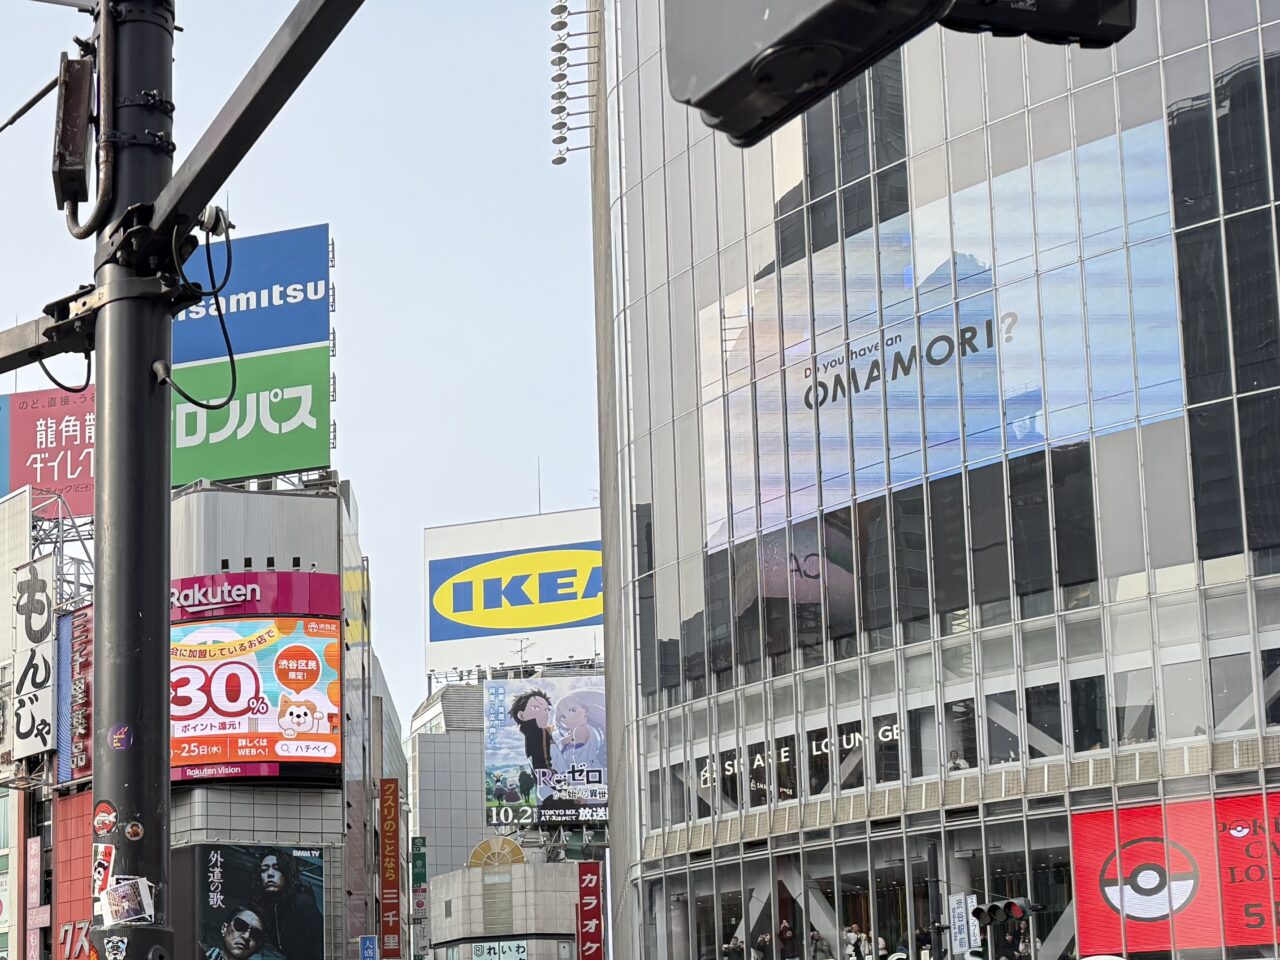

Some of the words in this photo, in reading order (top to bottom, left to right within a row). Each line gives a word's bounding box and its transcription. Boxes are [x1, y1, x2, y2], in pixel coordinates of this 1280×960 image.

[804, 312, 1018, 410] OMAMORI?
[822, 355, 844, 375] you
[851, 341, 879, 360] have
[885, 334, 902, 349] an
[170, 582, 260, 607] Rakuten
[16, 565, 52, 747] もんじゃ
[278, 660, 317, 670] 渋谷区民
[181, 721, 241, 733] ポイント還元!
[238, 739, 268, 747] 詳しくは
[238, 747, 268, 756] WEBへ!
[296, 744, 328, 753] ハチペイ
[186, 766, 217, 777] Rakuten
[218, 766, 241, 775] Vision
[490, 807, 532, 824] 10.2
[579, 807, 608, 820] 放送
[383, 783, 396, 880] クスリのことなら
[208, 851, 225, 909] 外道の歌
[382, 889, 399, 950] 三千里
[956, 899, 966, 948] 渋谷駅前
[486, 944, 527, 956] れいわ
